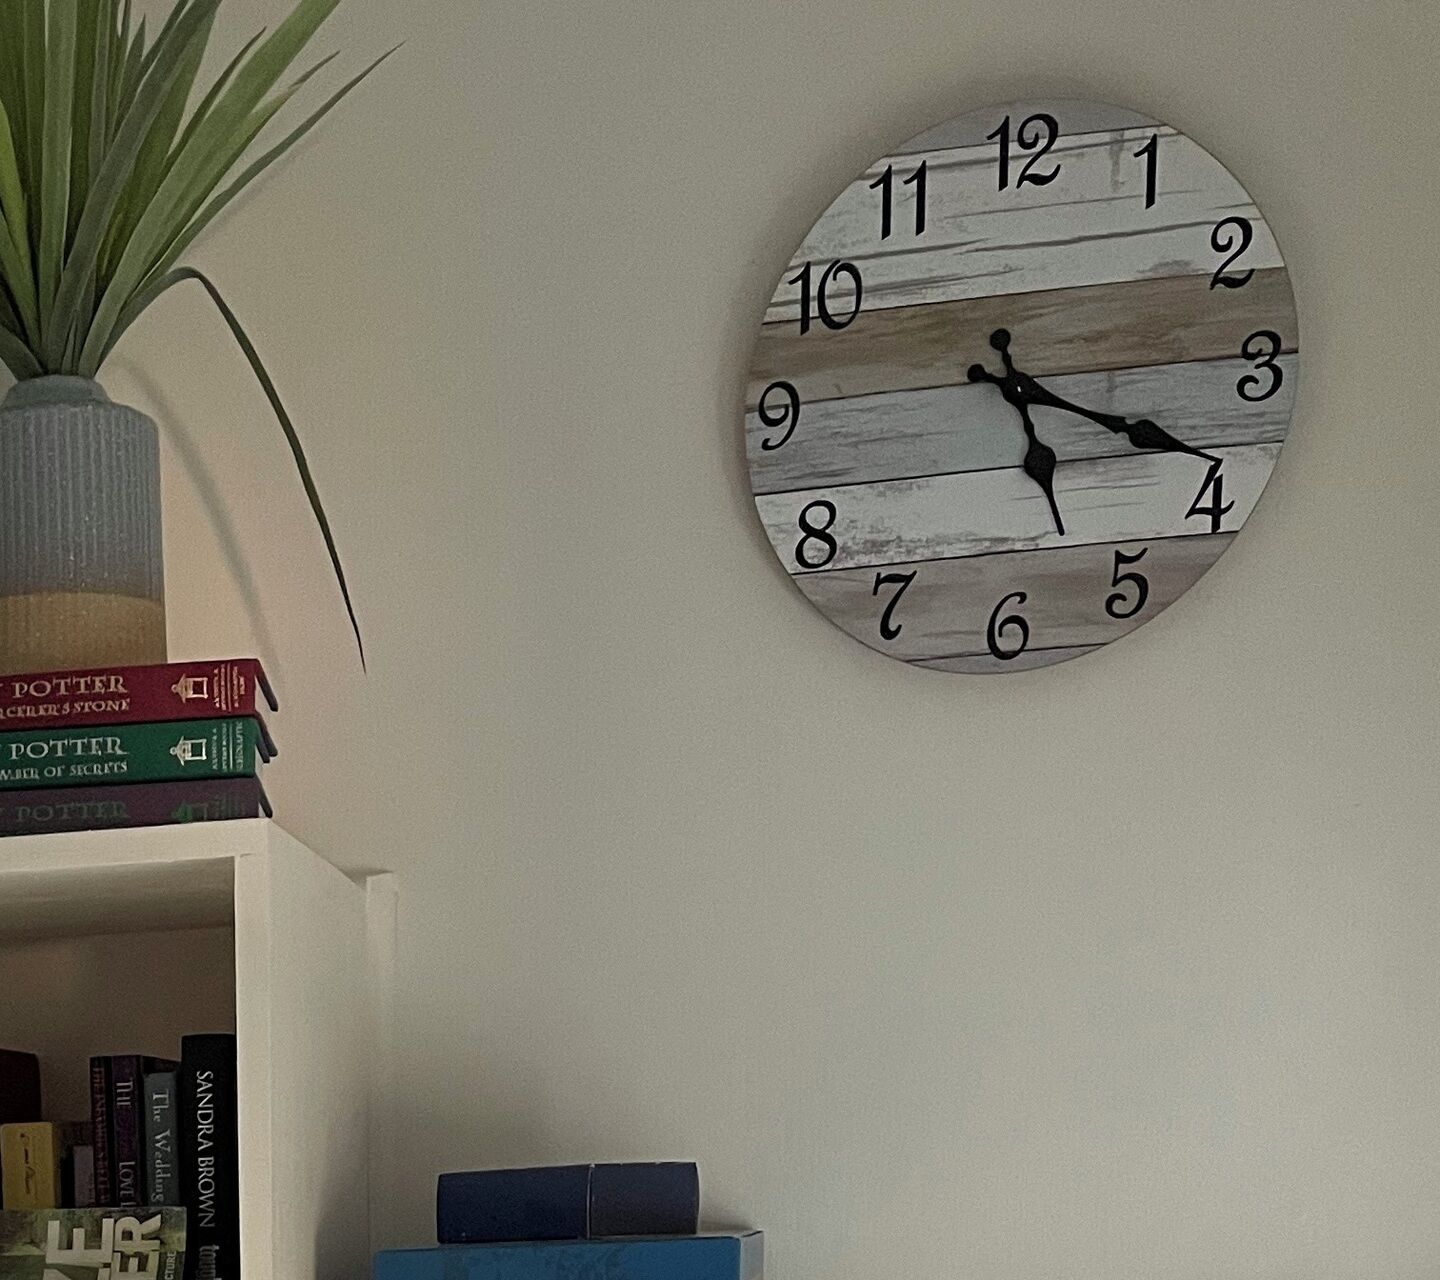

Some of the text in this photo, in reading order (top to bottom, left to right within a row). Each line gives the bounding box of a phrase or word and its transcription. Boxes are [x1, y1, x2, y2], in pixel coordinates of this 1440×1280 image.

[986, 113, 1061, 191] 12
[1133, 133, 1160, 209] 1
[869, 160, 928, 240] 11
[1209, 215, 1256, 290] 2
[788, 259, 864, 335] 10
[1236, 329, 1284, 401] 3
[758, 380, 801, 451] 9
[1184, 459, 1235, 534] 4
[794, 500, 838, 569] 8
[872, 569, 918, 640] 7
[1105, 546, 1150, 619] 5
[986, 591, 1030, 660] 6
[12, 675, 128, 699] POTTER
[73, 699, 131, 714] STONE
[11, 737, 128, 760] POTTER
[44, 765, 63, 777] OF
[69, 760, 128, 775] SECRETS
[15, 800, 129, 822] POTTER
[119, 1160, 137, 1198] LOVE
[150, 1089, 172, 1203] The Wedding
[196, 1070, 216, 1228] SANDRA BROWN
